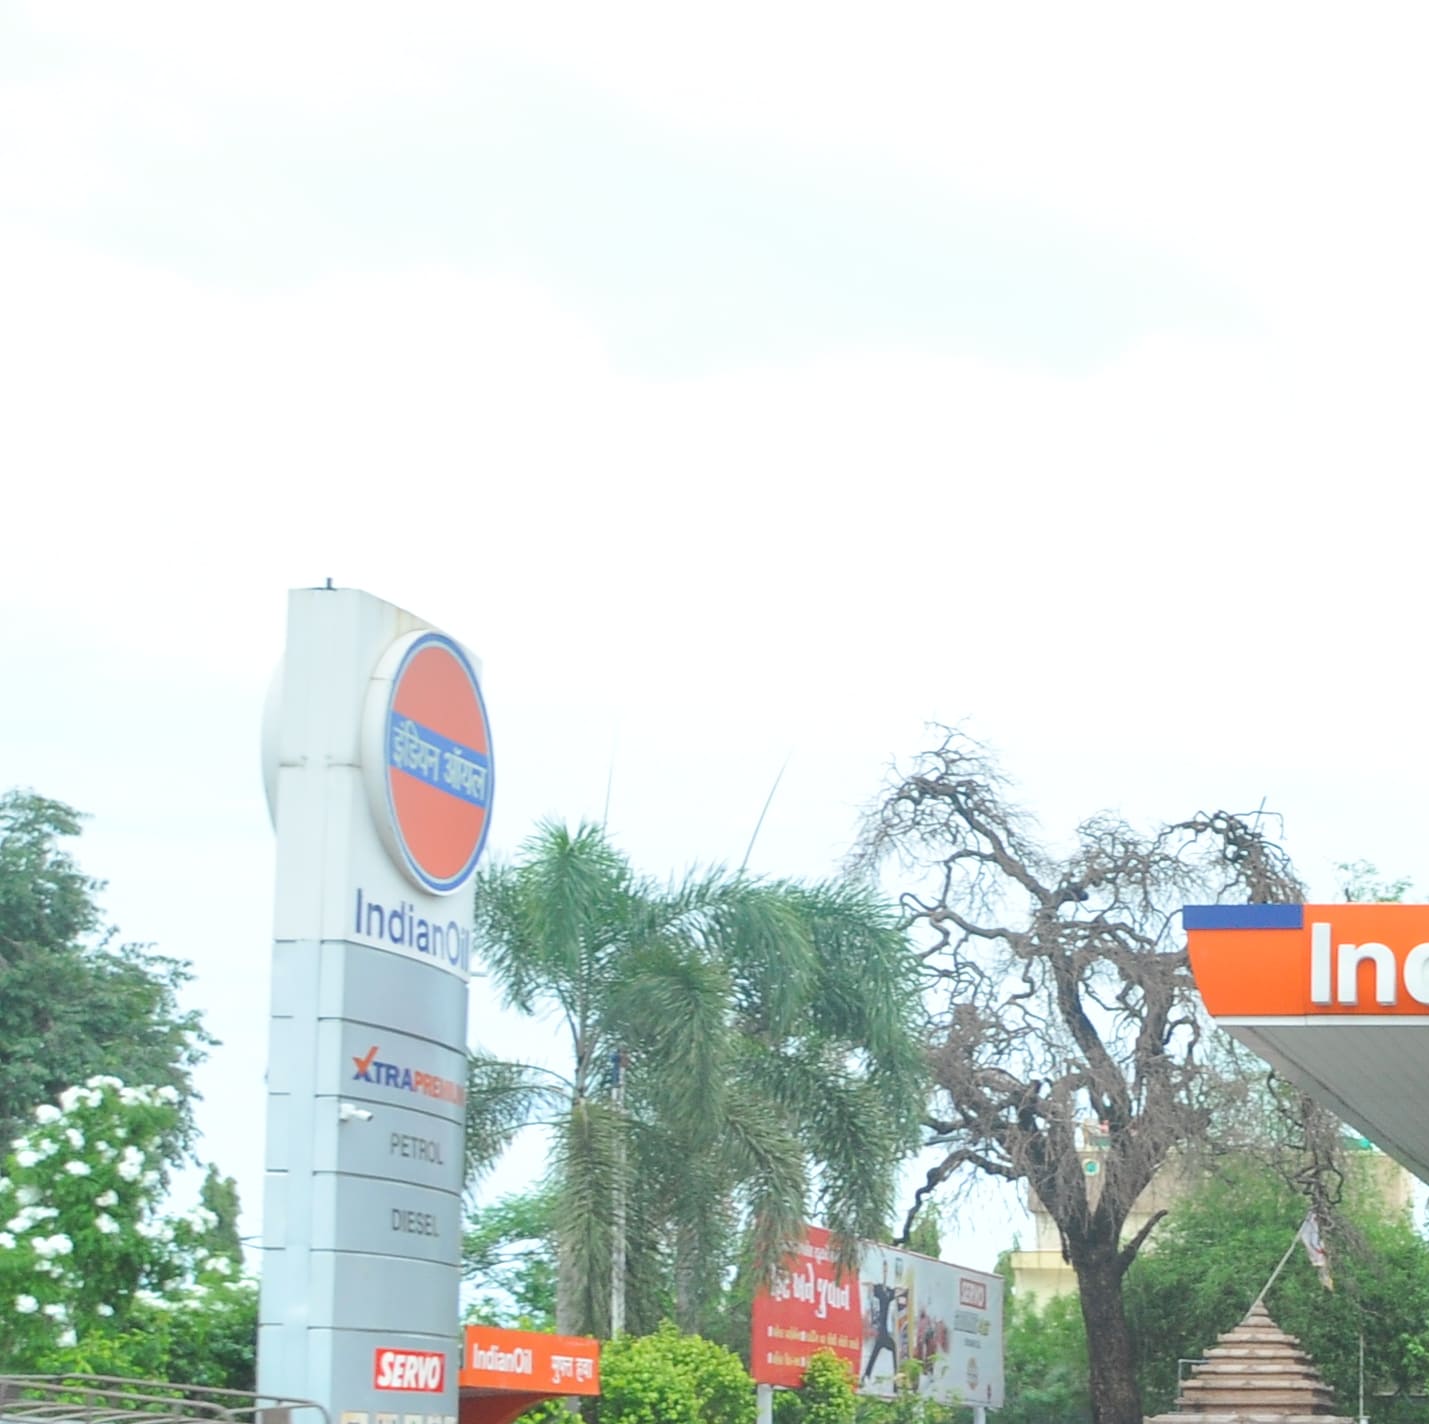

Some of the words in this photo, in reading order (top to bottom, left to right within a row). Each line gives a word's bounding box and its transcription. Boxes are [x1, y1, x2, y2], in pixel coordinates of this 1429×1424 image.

[392, 719, 441, 781] इंडियन
[443, 746, 488, 799] ऑयल
[355, 887, 471, 973] IndianOil
[389, 1131, 444, 1166] PETROL
[390, 1207, 441, 1237] DIESEL
[376, 1351, 443, 1390] SERVO
[472, 1343, 533, 1375] IndianOil
